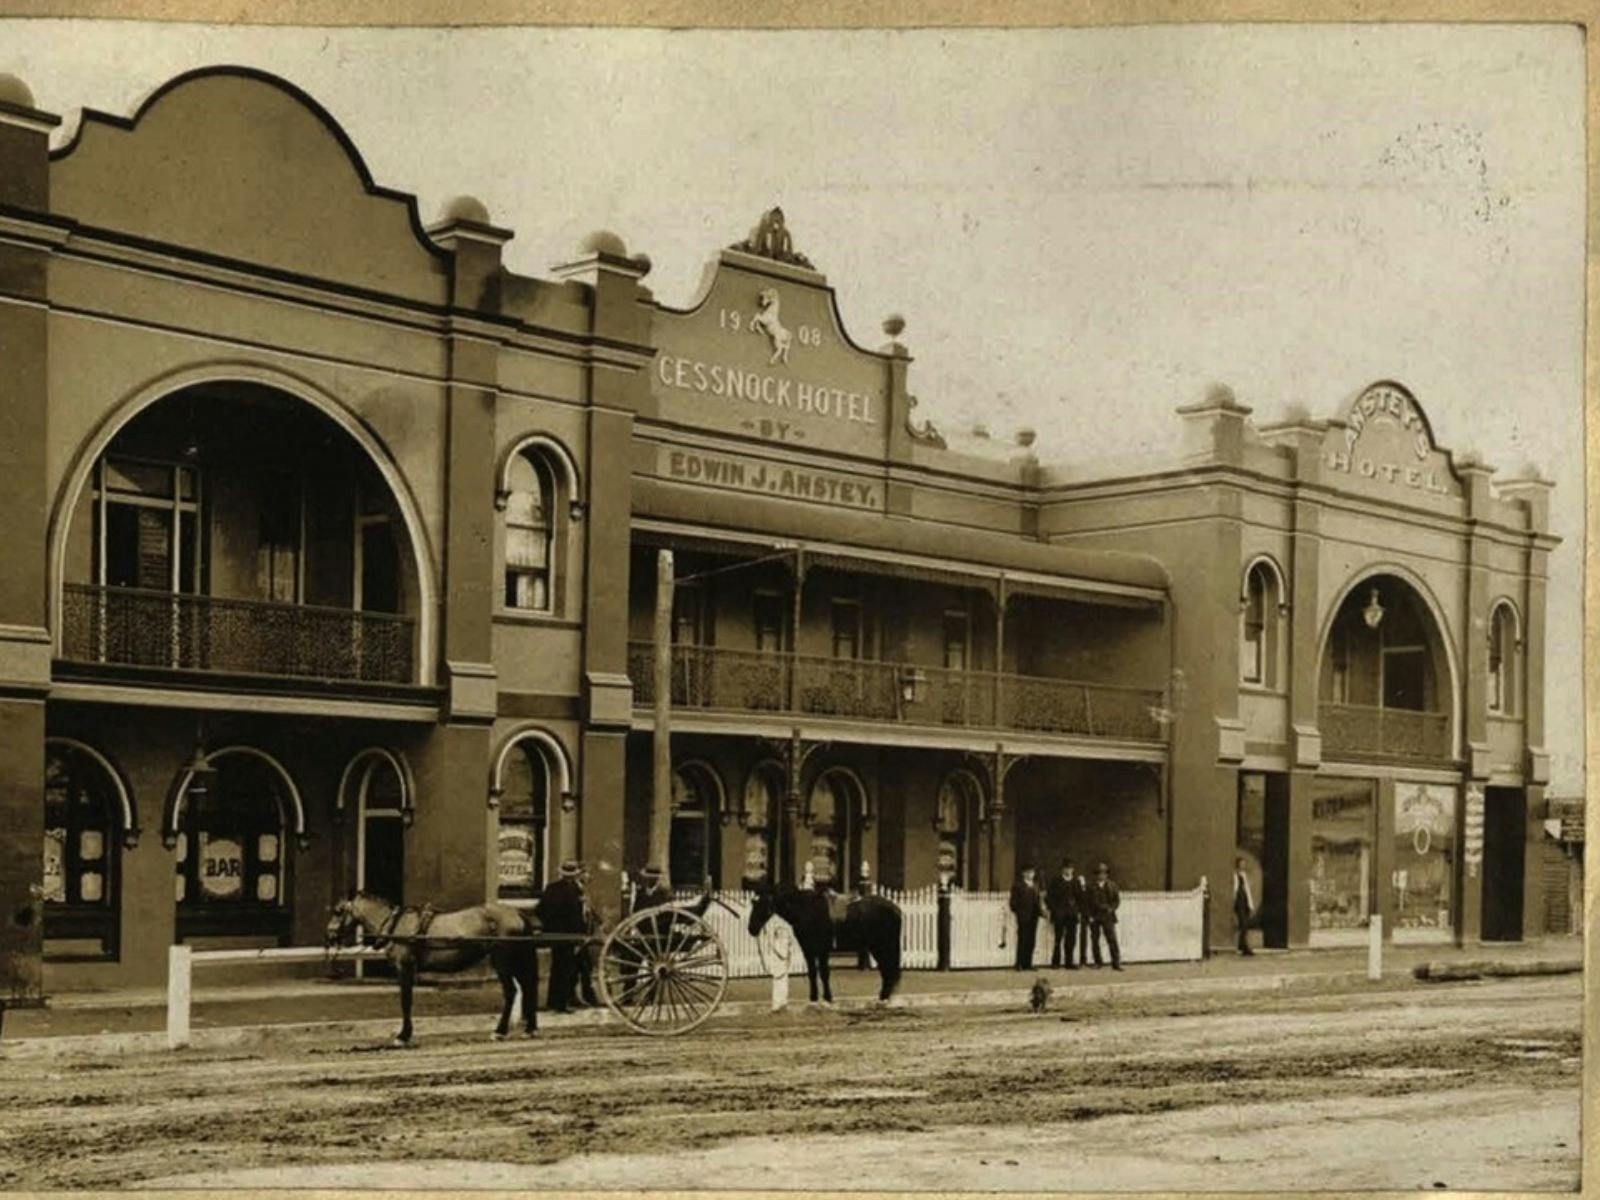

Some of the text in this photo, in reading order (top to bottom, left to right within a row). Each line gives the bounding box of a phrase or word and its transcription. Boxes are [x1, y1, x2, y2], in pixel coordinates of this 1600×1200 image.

[719, 308, 823, 347] 19 08
[659, 354, 879, 425] CESSNOCK HOTEL
[669, 450, 746, 487] EDWIN
[206, 857, 242, 877] BAR
